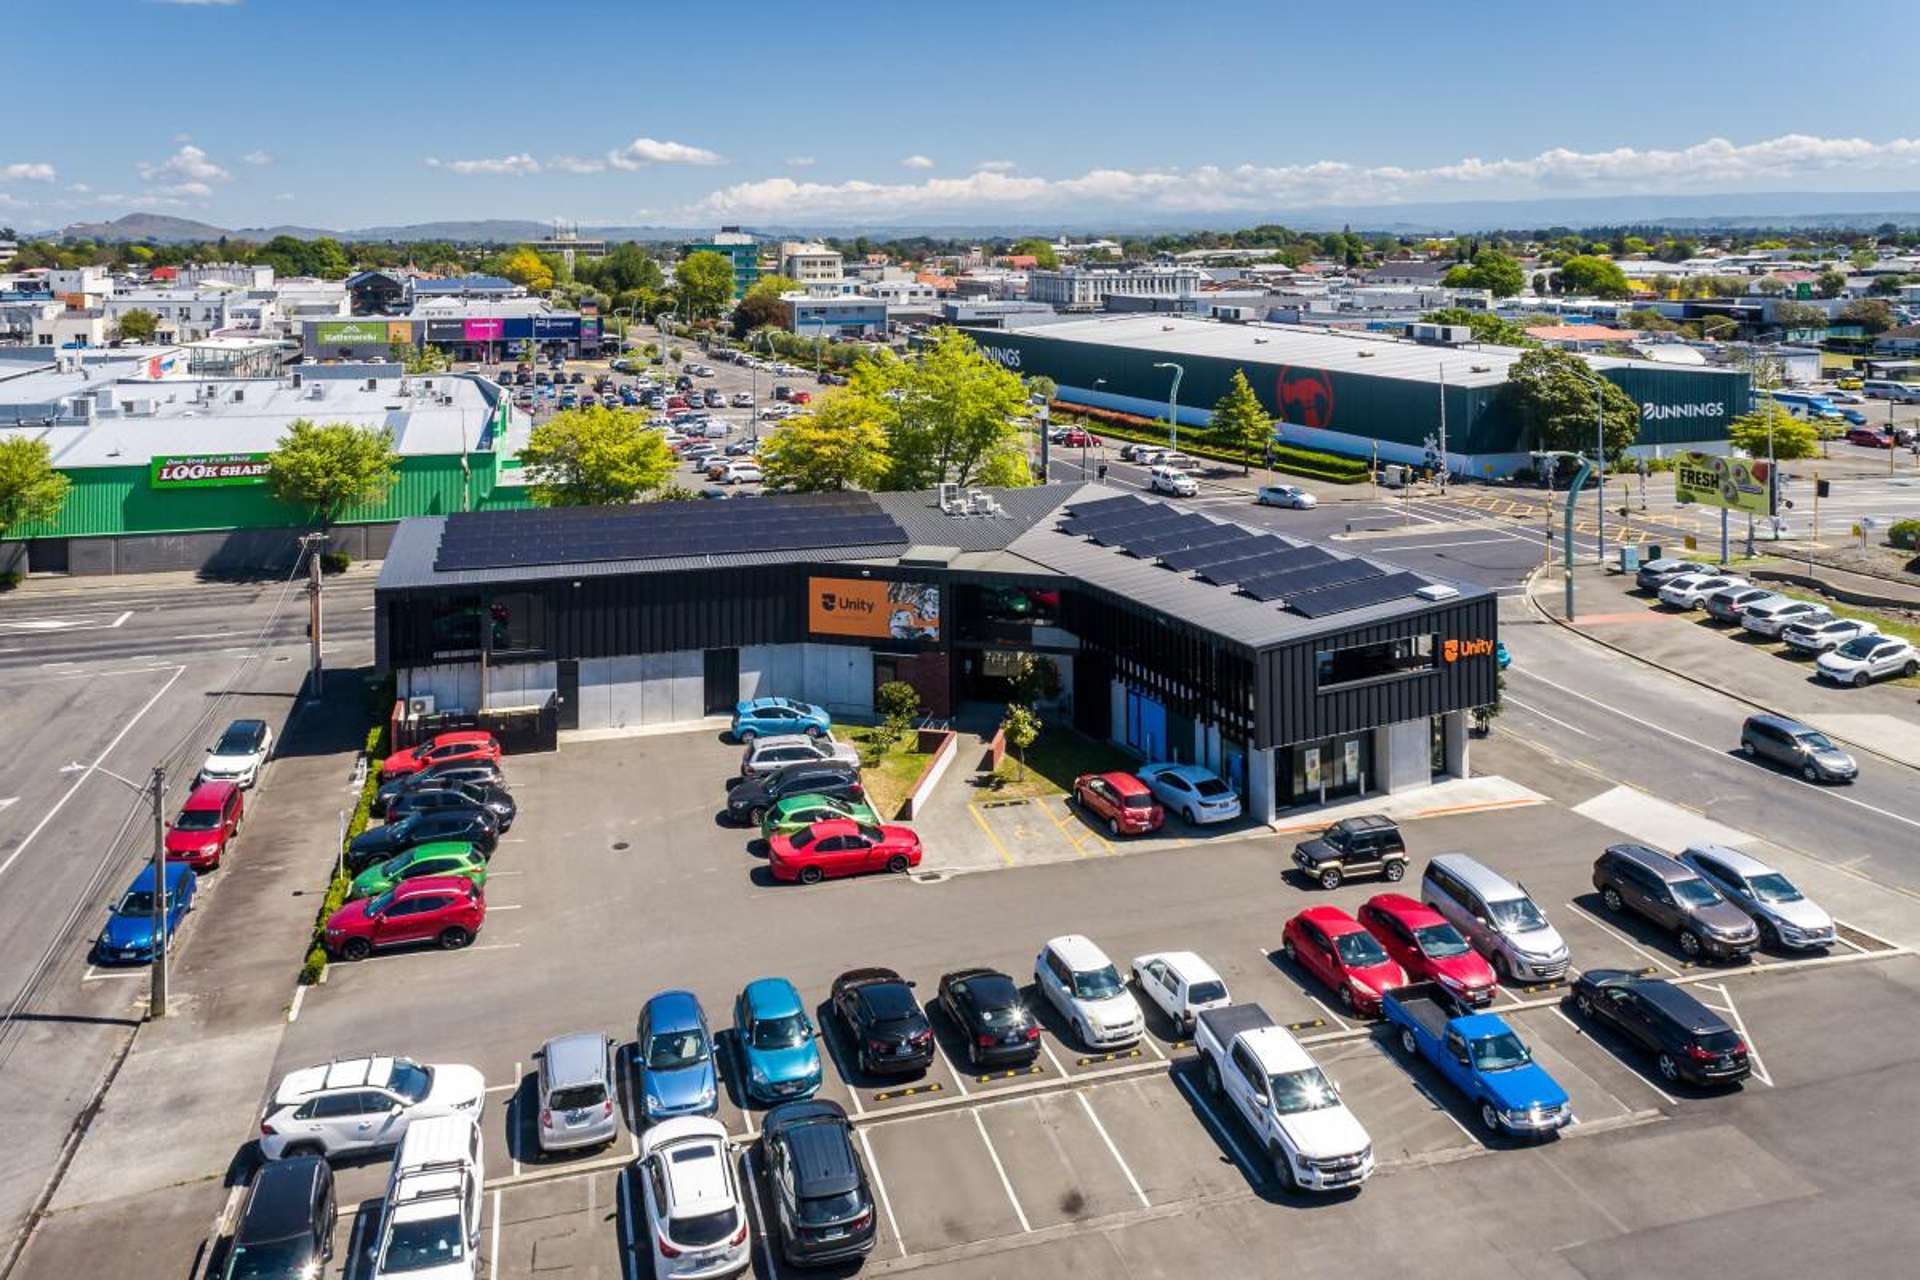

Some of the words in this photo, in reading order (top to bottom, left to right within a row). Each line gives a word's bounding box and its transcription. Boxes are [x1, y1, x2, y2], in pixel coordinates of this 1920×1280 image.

[1643, 402, 1724, 420] BUNNINGS
[161, 465, 219, 480] LOOK
[1680, 467, 1719, 490] FRESH
[839, 597, 874, 614] Unity
[1460, 639, 1494, 657] Unity
